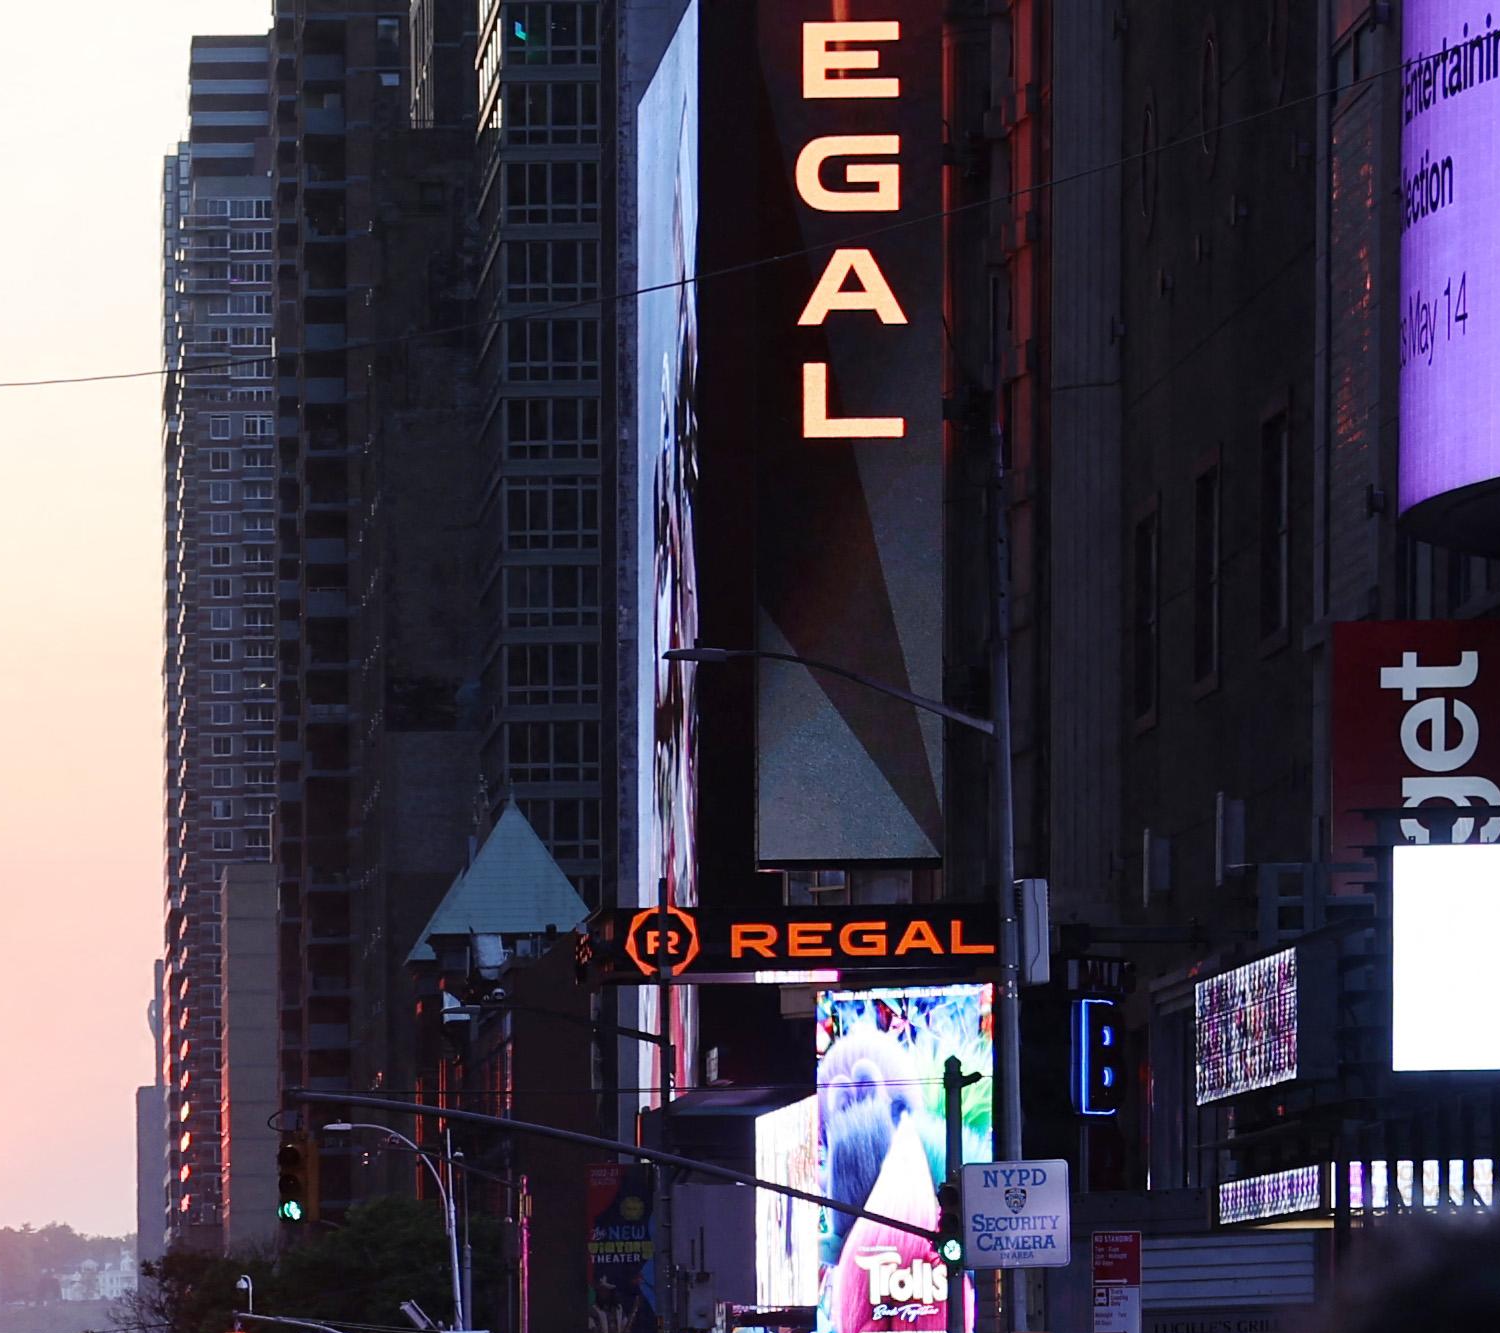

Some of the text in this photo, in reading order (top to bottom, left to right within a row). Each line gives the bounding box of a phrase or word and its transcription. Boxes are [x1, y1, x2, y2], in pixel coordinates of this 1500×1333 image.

[1408, 290, 1437, 366] May
[1444, 271, 1468, 341] 14
[730, 918, 996, 960] REGAL
[983, 1168, 1047, 1188] NYPD
[971, 1213, 1060, 1233] SECURITY
[976, 1233, 1056, 1252] CAMERA
[855, 1252, 948, 1305] Trolls
